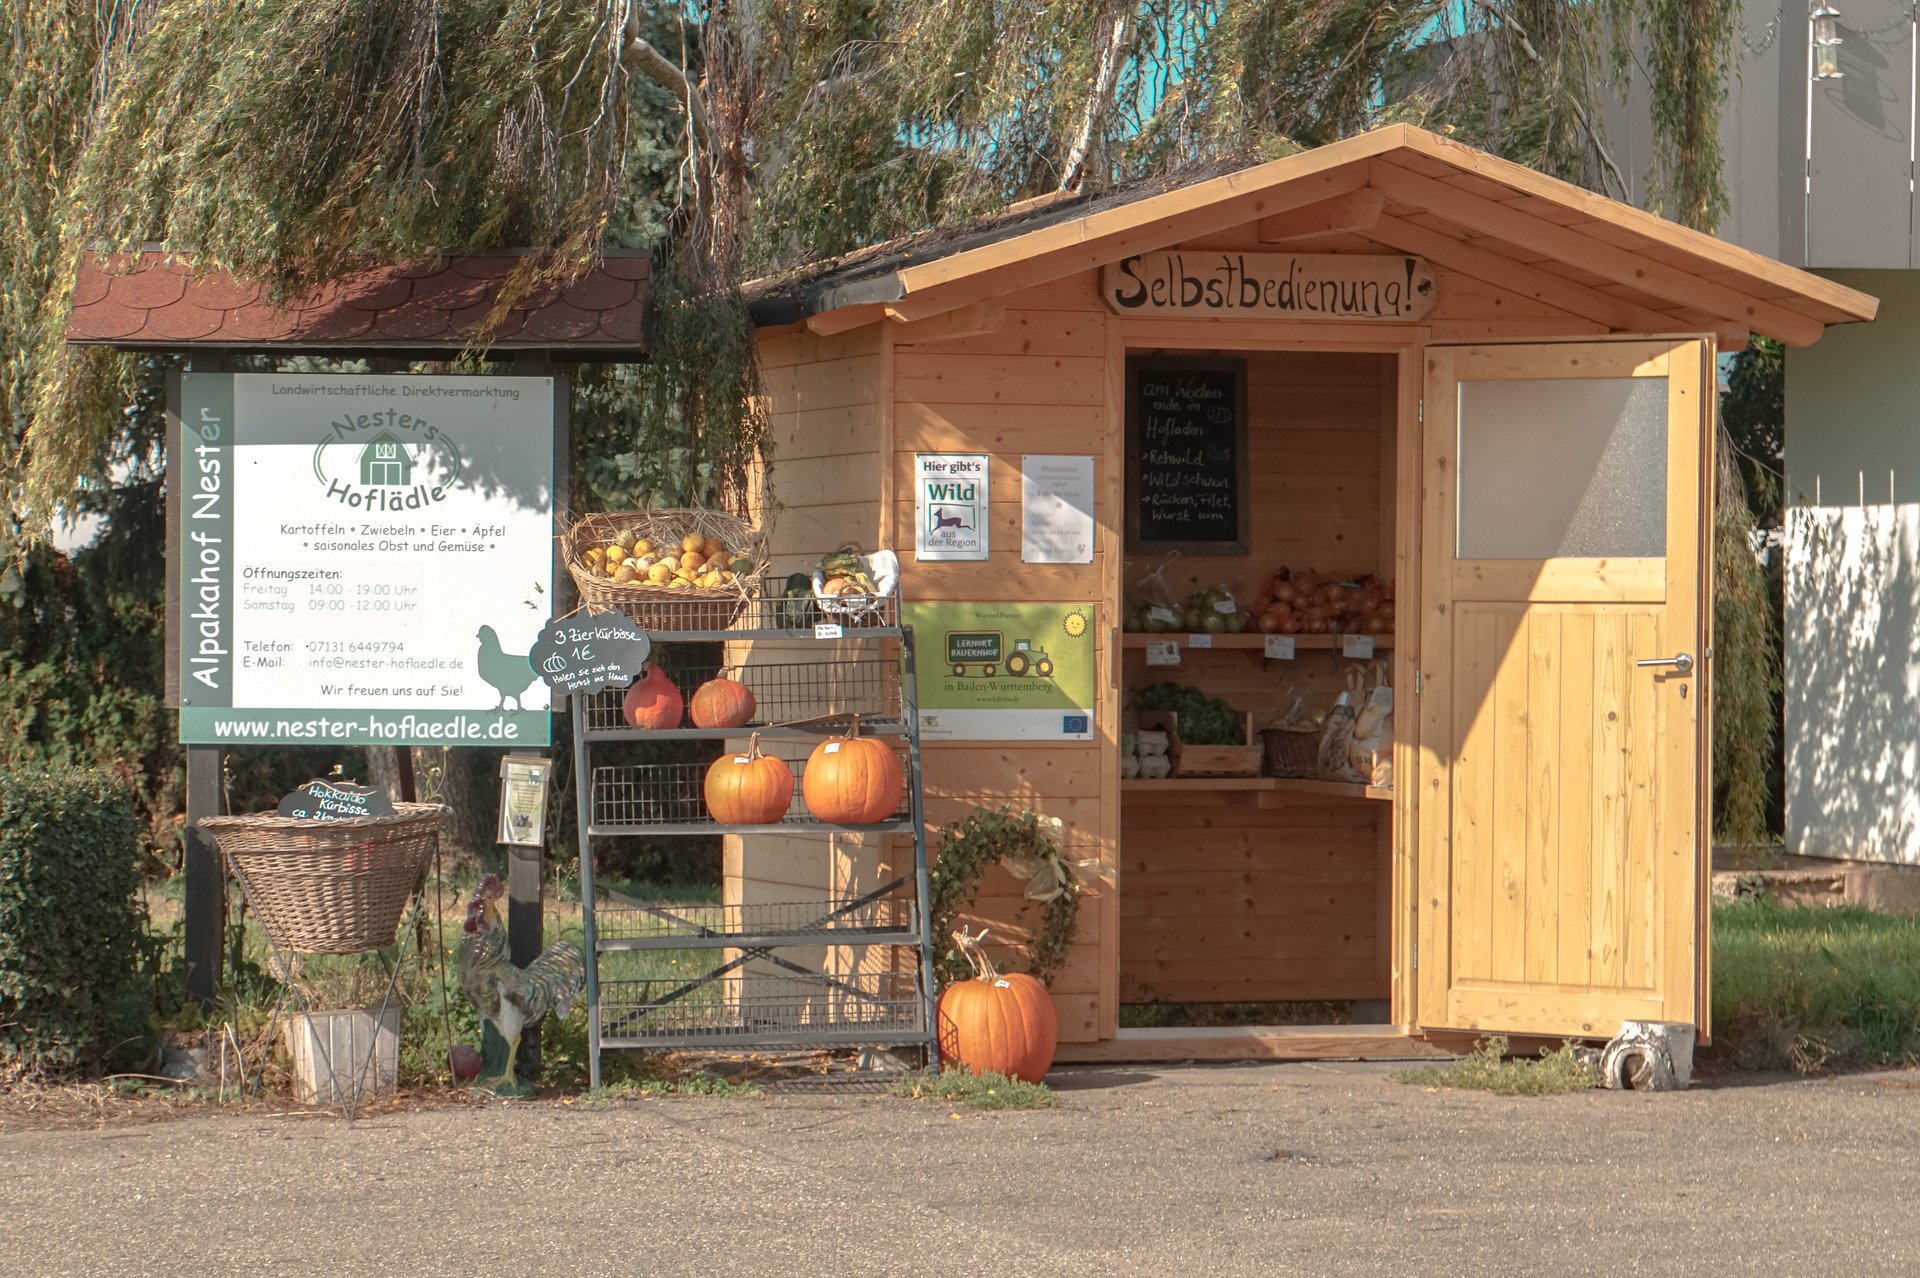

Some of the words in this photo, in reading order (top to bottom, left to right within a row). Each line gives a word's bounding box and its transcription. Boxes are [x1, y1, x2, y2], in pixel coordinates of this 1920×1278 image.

[1115, 254, 1416, 317] Selbstbedienung!
[271, 384, 396, 396] Landwirtschaftliche
[402, 386, 520, 400] Direktvermarktung
[1144, 383, 1170, 398] am
[1153, 400, 1182, 412] ende
[1187, 398, 1201, 411] im
[331, 408, 439, 440] Nesters
[192, 407, 221, 519] Nester
[923, 461, 947, 472] Hier
[950, 461, 981, 474] gibt's
[326, 478, 446, 512] Hoflädle
[928, 483, 975, 501] Wild
[1152, 508, 1190, 522] Wurst
[280, 524, 345, 536] Kartoffeln
[361, 524, 415, 536] Zwiebeln
[431, 525, 456, 537] Eier
[472, 523, 506, 539] Äpfel
[941, 530, 956, 538] aus
[313, 540, 374, 552] saisonales
[378, 540, 409, 552] Obst
[413, 540, 434, 552] und
[438, 540, 485, 552] Gemüse
[928, 538, 945, 547] der
[946, 538, 977, 549] Region
[243, 565, 343, 582] Öffnungszeiten:
[243, 583, 288, 597] Freitag
[309, 584, 343, 595] 14:00
[357, 584, 390, 595] 19:00
[394, 584, 418, 596] Uhr
[190, 531, 228, 688] Alpakahof
[243, 599, 295, 613] Samstag
[308, 600, 345, 611] 09:00
[357, 600, 390, 611] 12:00
[394, 600, 418, 612] Uhr
[554, 630, 567, 645] 3
[956, 639, 993, 648] LERNORT
[243, 641, 294, 653] Telefon:
[308, 641, 344, 653] 07131
[348, 641, 404, 653] 6449794
[571, 644, 596, 661] 1€
[951, 648, 999, 657] BAUERNHOF
[243, 656, 285, 668] E-Mail:
[552, 672, 576, 685] Holen
[567, 677, 591, 691] Herbst
[608, 671, 629, 682] Haus
[320, 684, 343, 696] Wir
[348, 684, 389, 697] freuen
[392, 686, 412, 697] uns
[415, 684, 436, 697] auf
[440, 684, 463, 697] Sie!
[944, 681, 954, 691] in
[957, 680, 1053, 694] Baden-Württemberg
[214, 714, 519, 740] www.nester-hoflaedle.de
[308, 785, 366, 805] Hokkaido
[319, 798, 371, 816] Kürbisse
